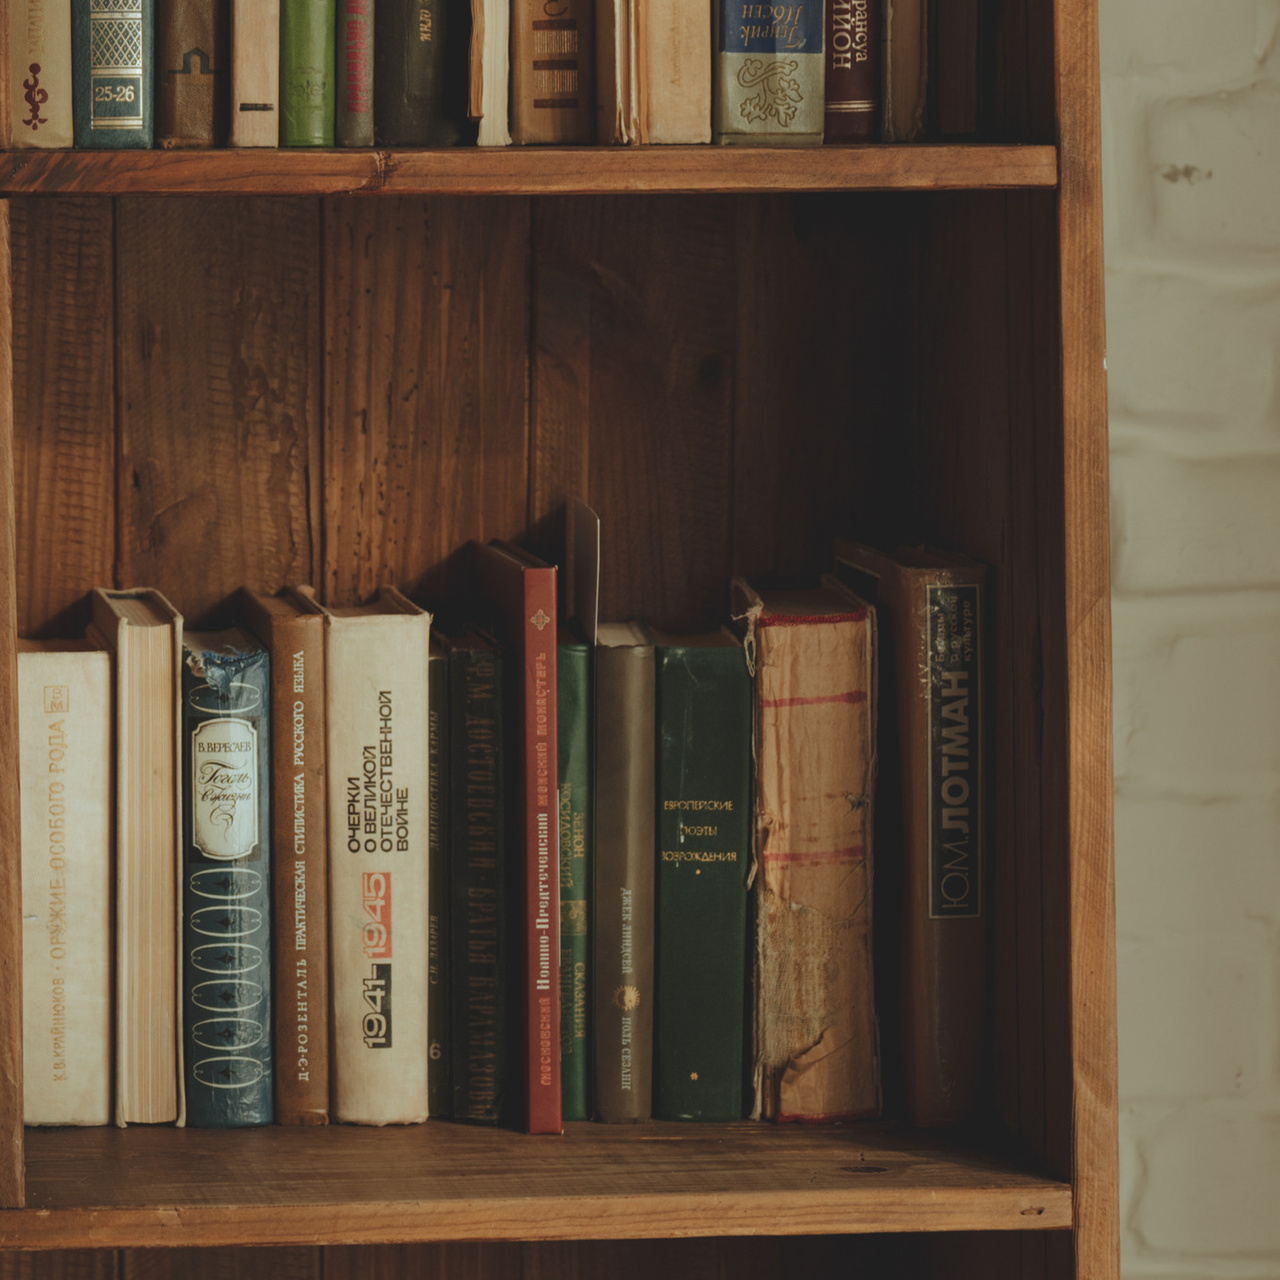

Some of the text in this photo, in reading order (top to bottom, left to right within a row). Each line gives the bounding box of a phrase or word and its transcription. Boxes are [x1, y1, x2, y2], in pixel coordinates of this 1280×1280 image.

[419, 8, 433, 43] огни
[95, 85, 135, 103] 25-26
[347, 20, 369, 113] ПРАВИЛЬНО
[962, 600, 974, 662] культуре
[47, 719, 70, 778] РОДА
[197, 758, 253, 790] Гоголь
[378, 689, 394, 853] ОТЕЧЕСТВЕННОЙ
[48, 782, 66, 872] ОСОБОГО
[293, 650, 307, 950] ПРАКТИЧЕСКАЯ СТИЛИСТИКА РУССКОГО ЯЗЫКА
[347, 776, 361, 853] ОЧЕРКИ
[361, 744, 377, 853] О ВЕЛИКОЙ
[394, 786, 409, 853] ВОЙНЕ
[560, 782, 574, 889] КОСИДОВСКИЙ
[573, 812, 585, 859] ЗЕНОН
[48, 877, 66, 960] ОРУЖИЕ
[363, 872, 391, 960] 1945
[467, 886, 498, 964] БРАТЬЯ
[619, 886, 633, 974] ДЖЕК ЛИНДСЕЙ
[574, 961, 586, 1038] СКАЗАНИЯ
[429, 1043, 441, 1060] 6
[468, 976, 498, 1119] КАРАМАЗОВЫ
[620, 1016, 632, 1090] ПОЛЬ СЕЗАНН
